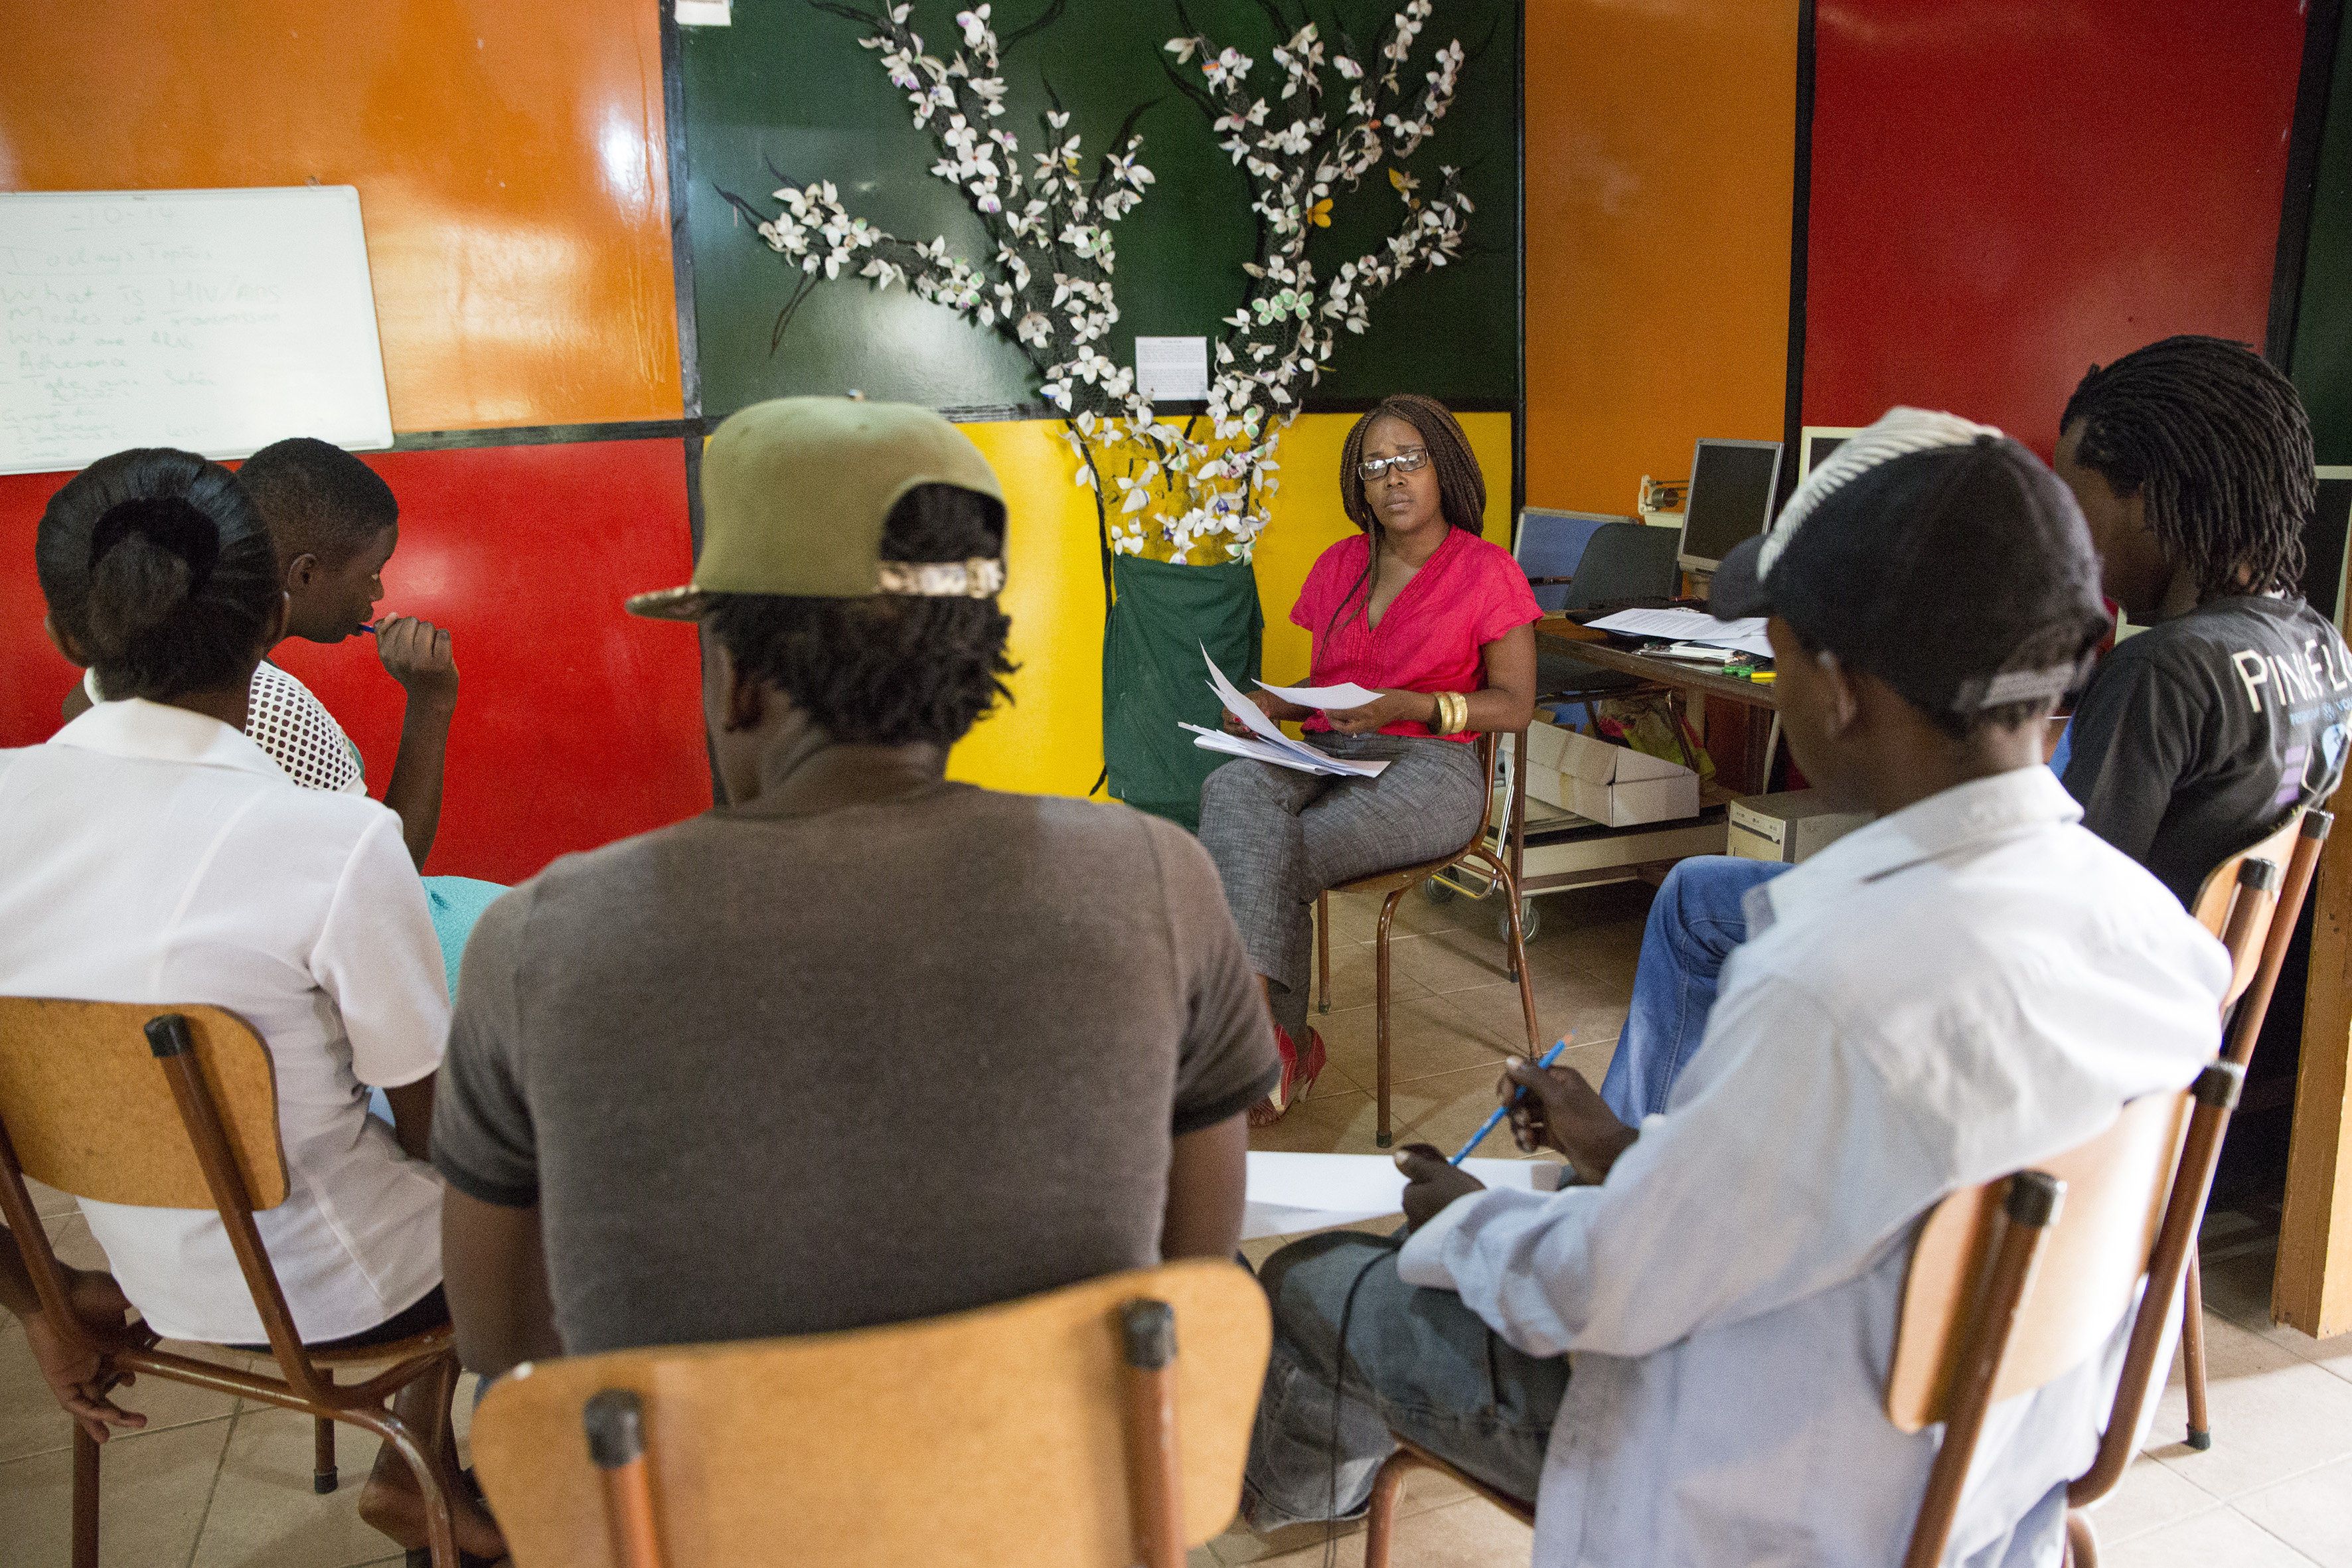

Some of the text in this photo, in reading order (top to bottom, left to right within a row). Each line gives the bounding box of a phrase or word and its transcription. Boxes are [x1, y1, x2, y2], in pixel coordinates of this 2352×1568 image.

[0, 282, 98, 305] What
[8, 305, 101, 327] Modes
[7, 329, 80, 347] What
